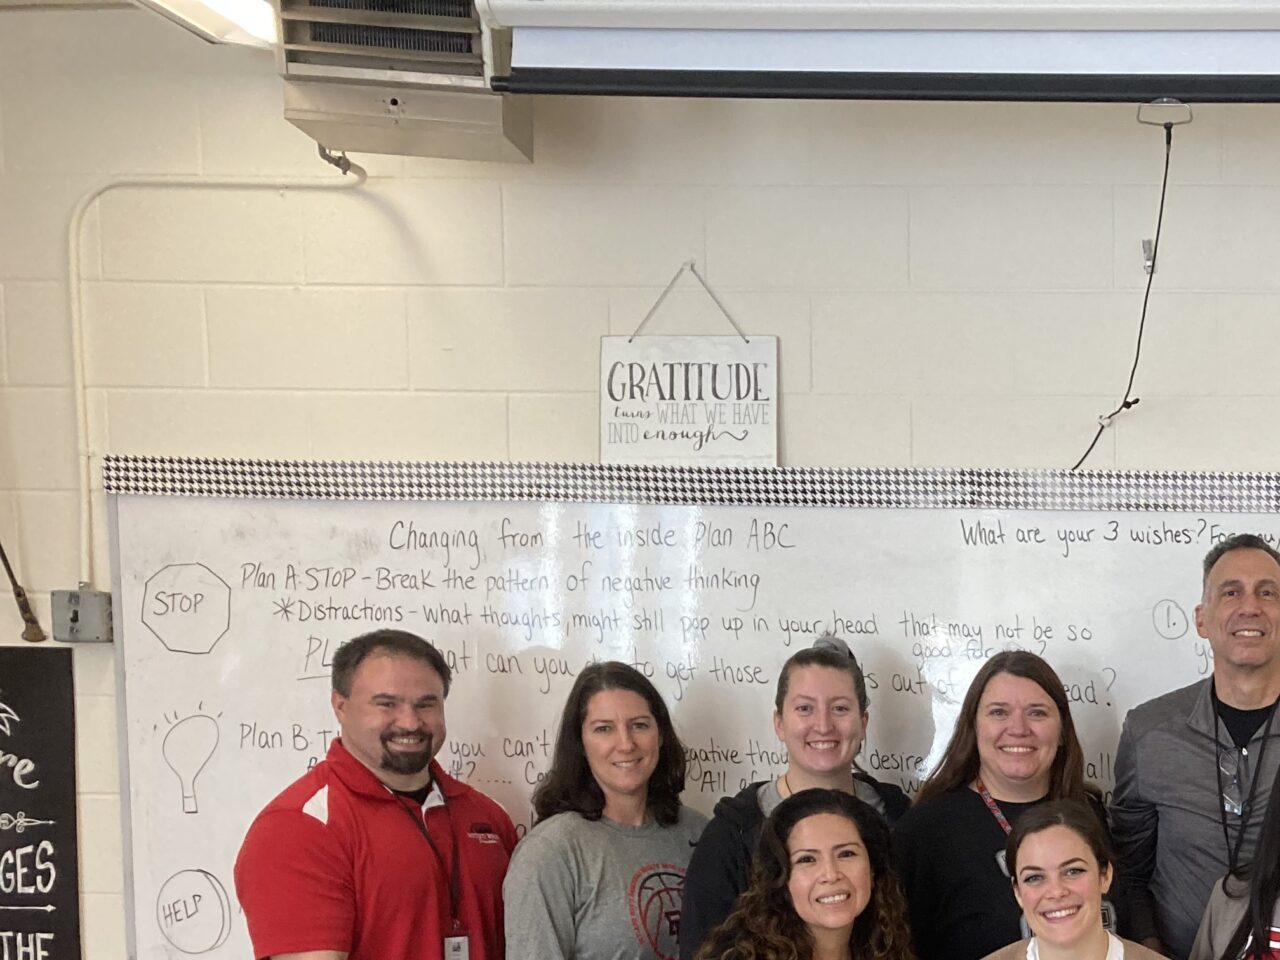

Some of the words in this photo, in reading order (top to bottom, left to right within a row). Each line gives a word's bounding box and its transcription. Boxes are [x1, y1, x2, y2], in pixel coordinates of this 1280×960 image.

[607, 360, 770, 402] GRATITUDE
[614, 405, 652, 419] turns
[656, 402, 697, 425] WHAT
[704, 402, 727, 425] WE
[732, 402, 770, 425] HAVE
[608, 422, 639, 444] INTO
[643, 424, 748, 451] enough
[389, 519, 481, 571] Changing
[498, 517, 544, 549] from
[572, 520, 605, 549] the
[617, 521, 677, 548] inside
[695, 520, 733, 549] Plan
[748, 518, 796, 552] ABC
[960, 518, 1006, 546] What
[1016, 523, 1046, 545] are
[1057, 525, 1096, 558] your
[1103, 520, 1120, 542] 3
[1130, 518, 1207, 546] wishes?
[153, 591, 204, 616] STOP
[241, 562, 275, 591] Plan
[375, 566, 437, 591] Break
[442, 568, 477, 590] the
[486, 567, 549, 600] pattern
[566, 560, 592, 592] of
[601, 566, 673, 608] negative
[684, 564, 761, 612] thinking
[573, 608, 620, 643] might
[633, 607, 664, 632] still
[681, 614, 710, 643] pop
[722, 616, 743, 641] up
[753, 613, 769, 632] in
[779, 617, 823, 647] your
[833, 609, 879, 637] head
[899, 610, 945, 638] that
[948, 623, 983, 650] may
[996, 613, 1025, 640] not
[1033, 615, 1053, 641] be
[1067, 623, 1093, 642] so
[485, 648, 524, 676] can
[533, 655, 575, 695] you
[666, 652, 696, 699] get
[708, 656, 769, 685] those
[892, 672, 927, 695] out
[912, 639, 953, 672] good
[962, 639, 994, 661] for
[239, 721, 283, 750] Plan
[449, 741, 486, 770] you
[503, 729, 551, 758] can't
[0, 840, 56, 894] GES
[163, 895, 201, 927] HELP
